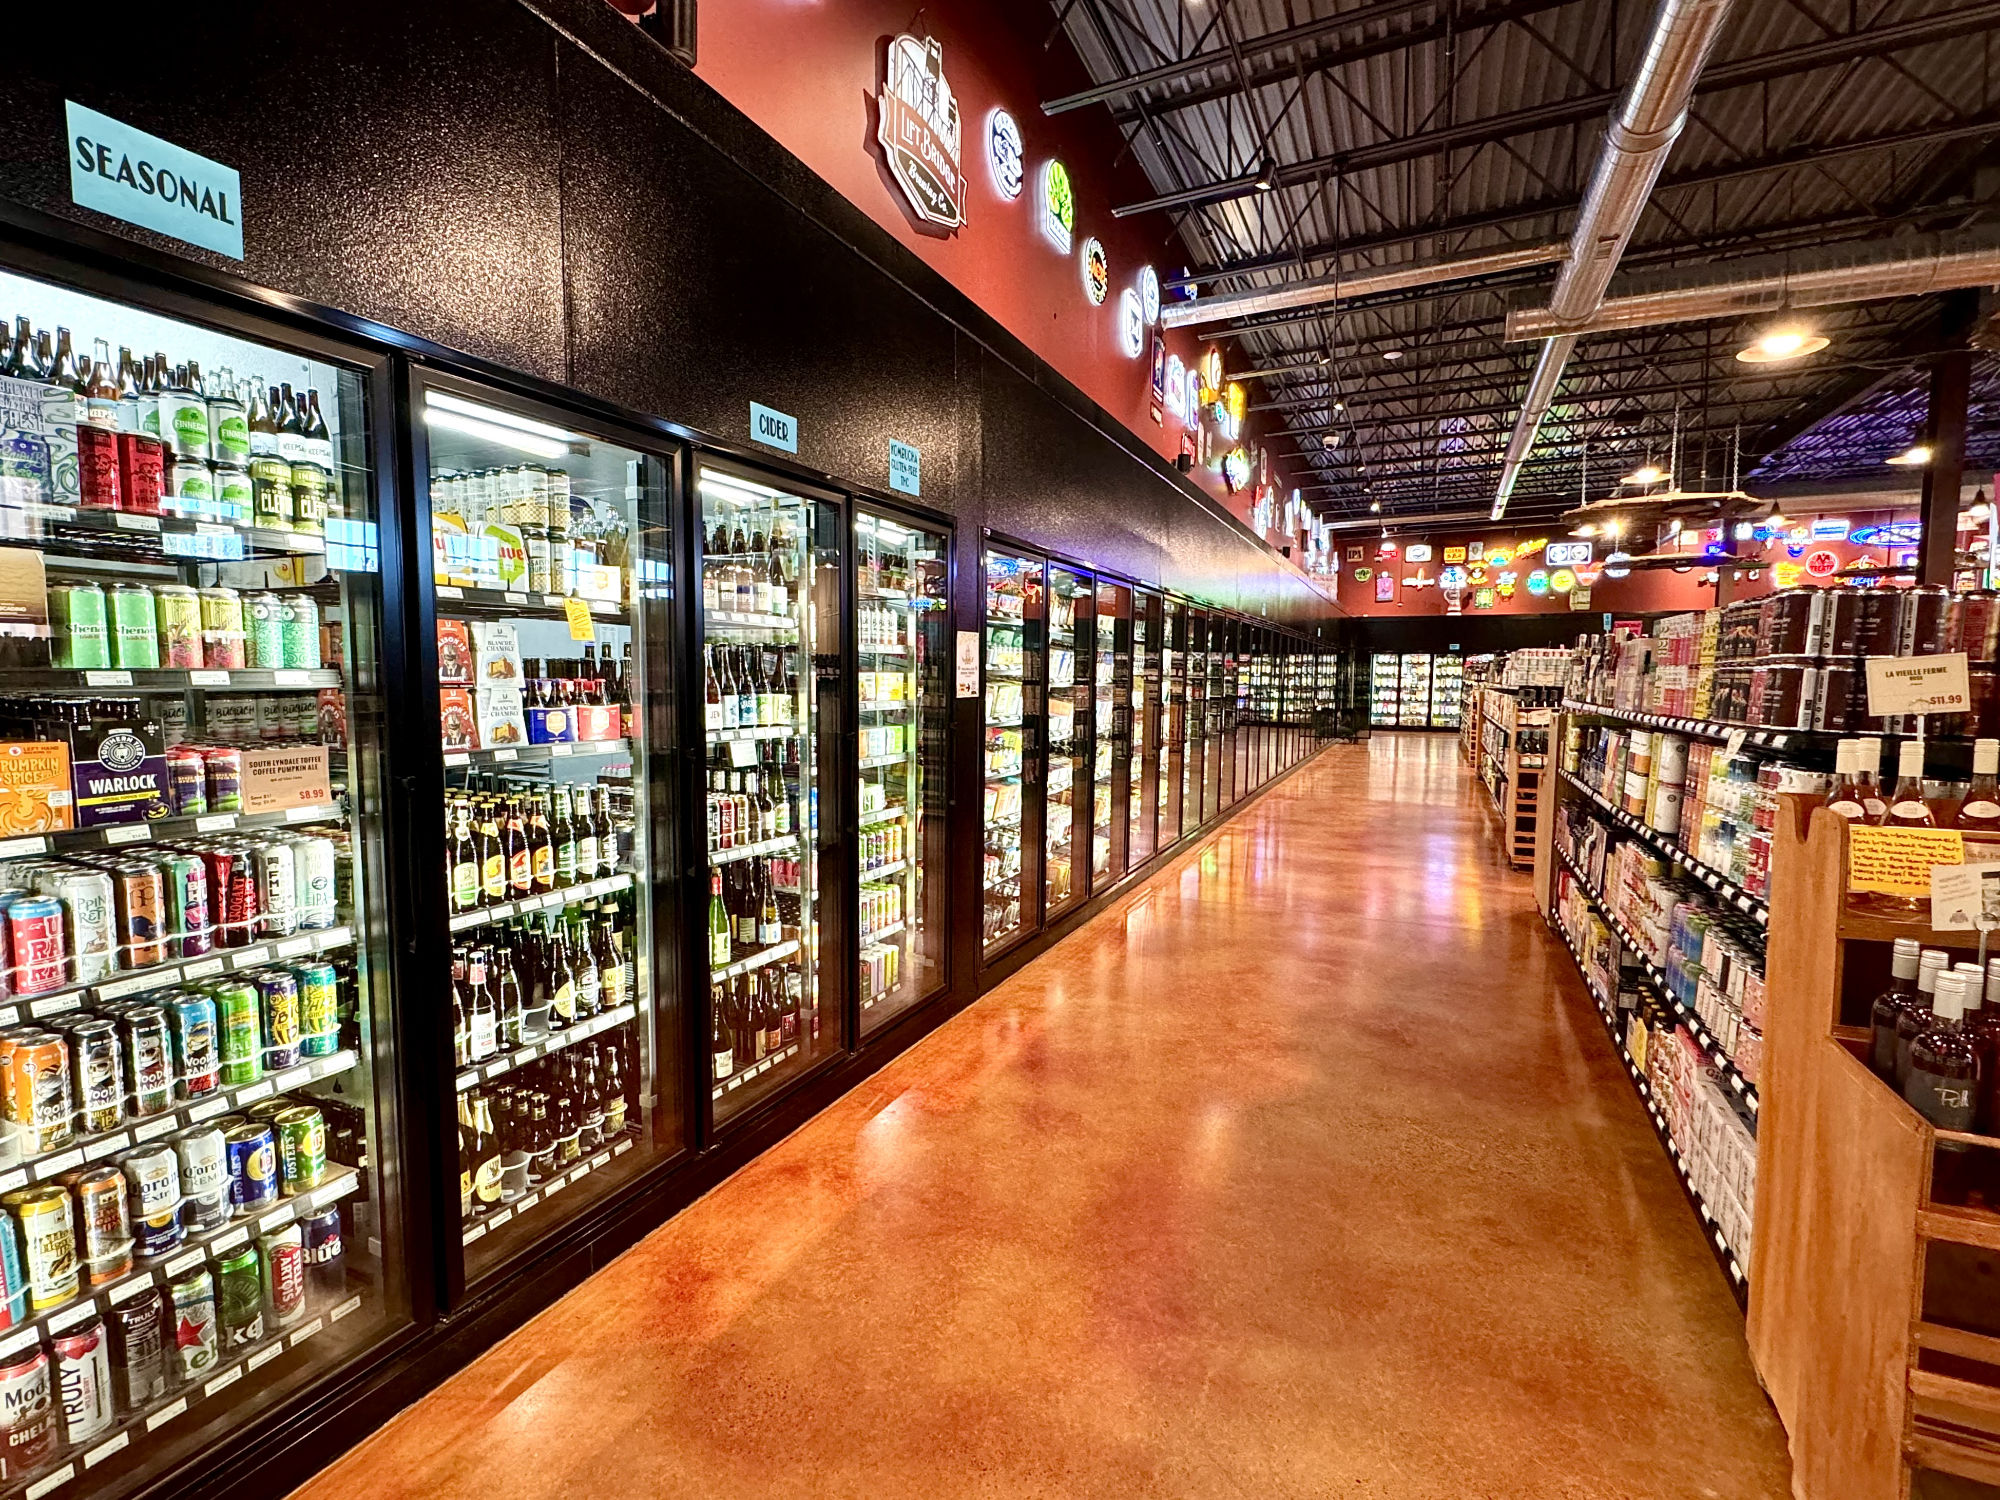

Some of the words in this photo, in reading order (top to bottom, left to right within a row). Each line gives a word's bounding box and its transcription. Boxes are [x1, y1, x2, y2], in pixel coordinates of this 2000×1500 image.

[75, 135, 235, 227] SEASONAL
[759, 412, 789, 443] CIDER
[1884, 670, 1895, 679] LA
[1895, 668, 1921, 677] VIEILLE
[1922, 666, 1948, 675] FERME
[101, 735, 134, 759] SOUTHERN
[0, 757, 60, 773] PUMPKIN
[248, 759, 272, 769] SOUTH
[272, 757, 299, 767] LYNDALE
[300, 755, 322, 764] TOFFEE
[252, 767, 277, 776] COFFEE
[277, 765, 306, 774] PUMPKIN
[307, 763, 318, 771] ALE
[3, 770, 41, 785] SPICE
[88, 774, 157, 795] WARLOCK
[299, 788, 324, 801] $8.99
[285, 1134, 298, 1180] FOSTER'S
[302, 1240, 342, 1265] Blue
[280, 1257, 295, 1303] ARTOIS
[291, 1248, 304, 1299] STELLA
[128, 1310, 156, 1325] TRULY
[61, 1367, 85, 1426] TRULY
